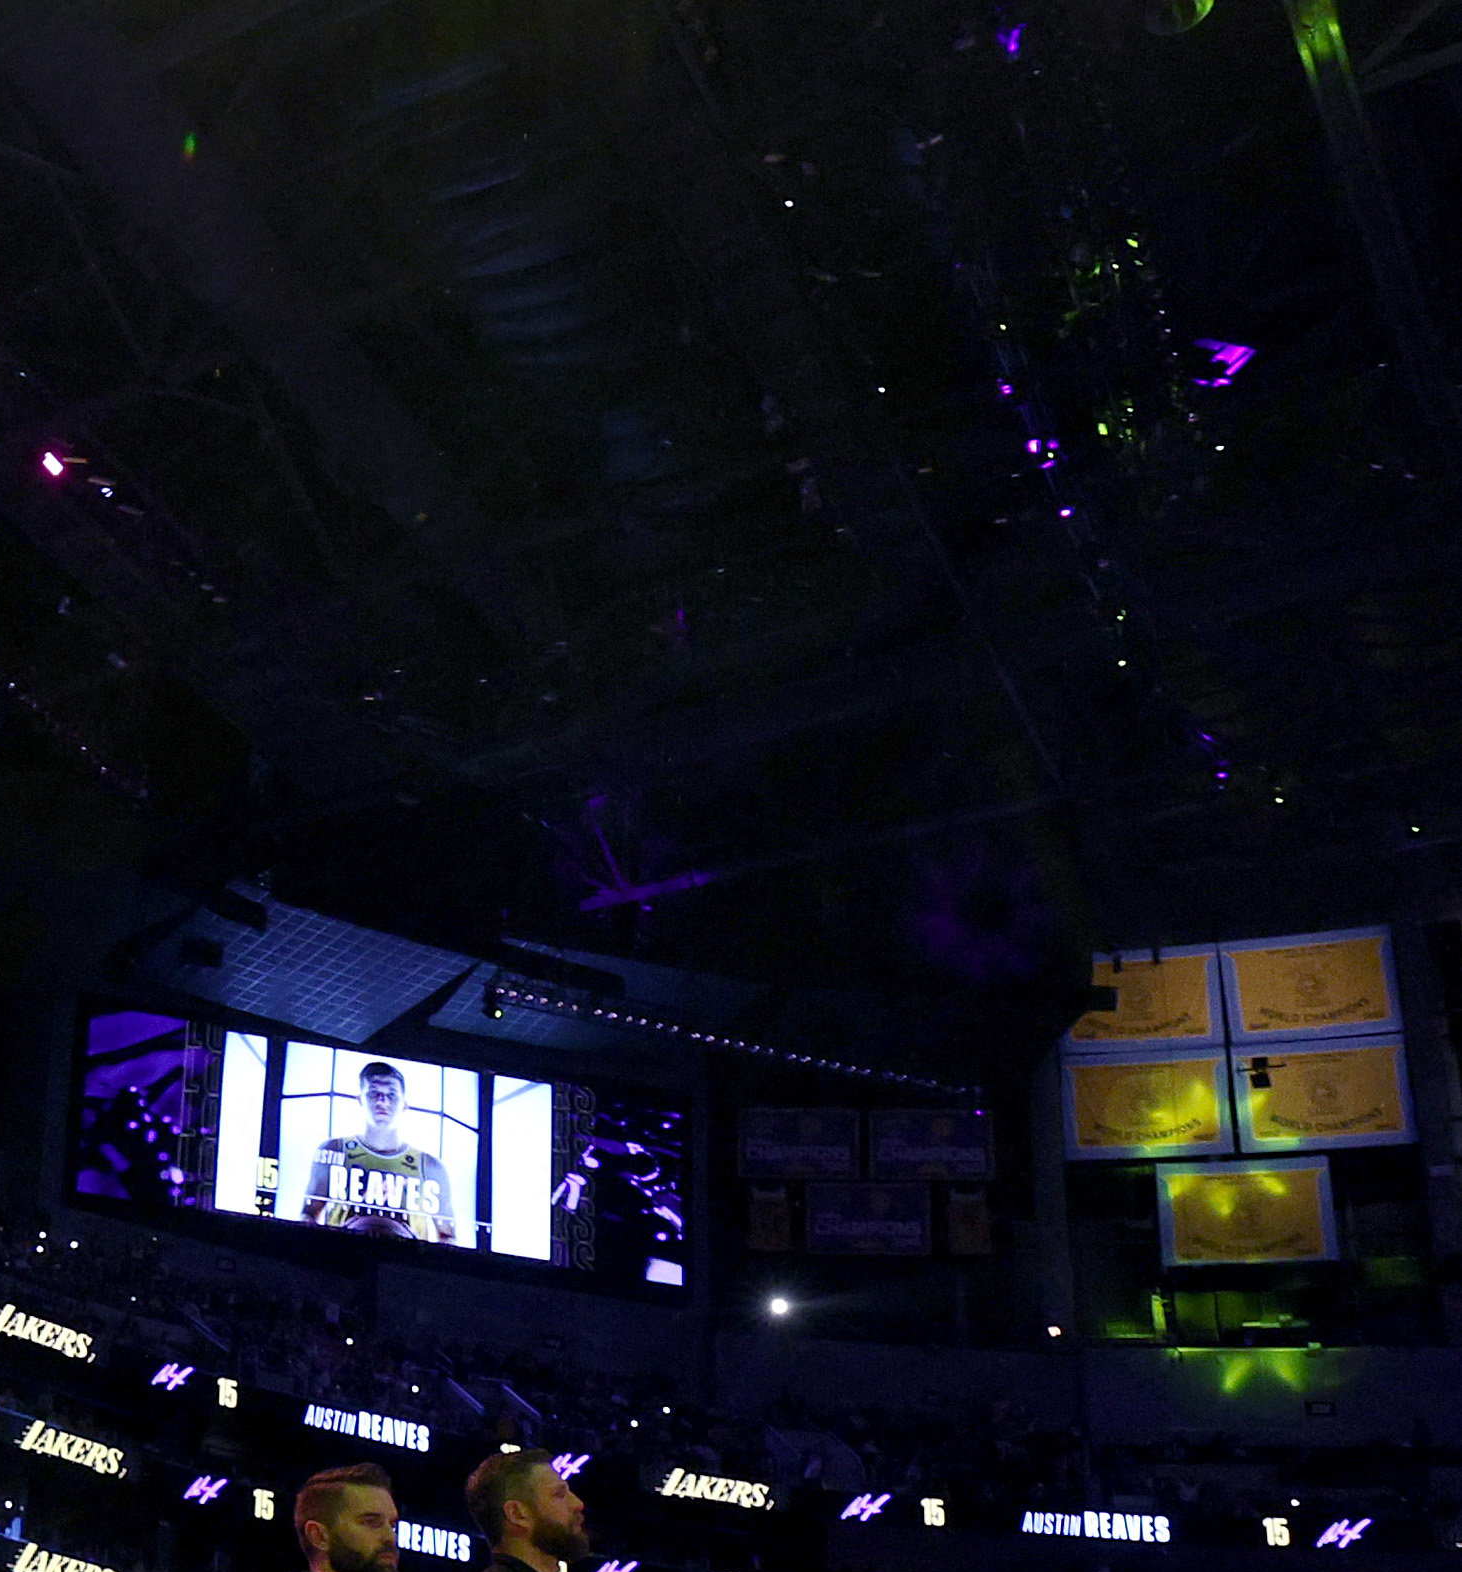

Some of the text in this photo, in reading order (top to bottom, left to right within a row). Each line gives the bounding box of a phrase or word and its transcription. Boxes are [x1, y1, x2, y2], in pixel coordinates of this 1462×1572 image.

[256, 1156, 279, 1190] 15
[328, 1165, 442, 1215] REAVES
[216, 1377, 238, 1409] 15
[304, 1404, 430, 1453] AUSTIN REAVES
[252, 1488, 275, 1521] 15
[920, 1497, 946, 1527] 15
[397, 1520, 471, 1562] REAVES
[1021, 1510, 1171, 1543] AUSTIN REAVES
[1262, 1517, 1291, 1547] 15
